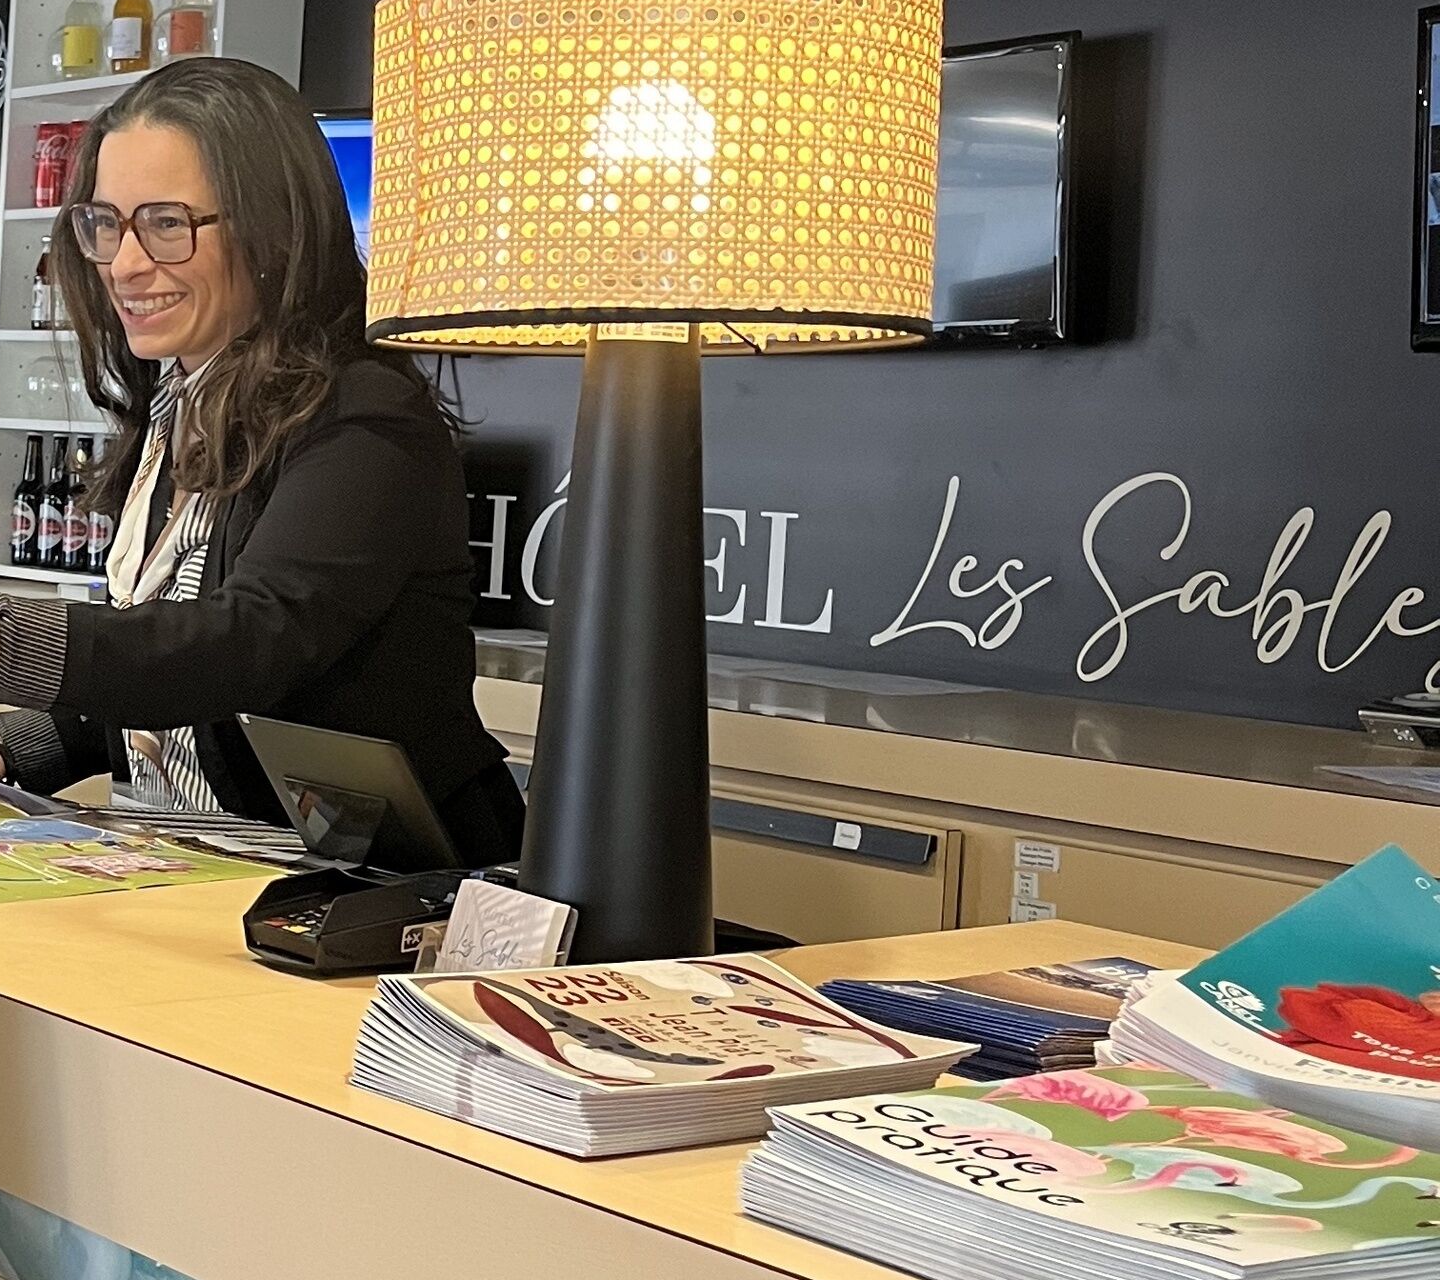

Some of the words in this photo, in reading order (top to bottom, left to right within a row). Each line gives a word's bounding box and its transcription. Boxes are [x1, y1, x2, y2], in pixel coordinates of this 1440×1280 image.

[466, 469, 834, 634] HEL
[870, 475, 1053, 650] Les
[1076, 471, 1440, 694] Sable
[523, 976, 589, 1006] 23
[564, 973, 629, 1004] 22
[603, 970, 651, 1001] Saison
[648, 1012, 713, 1038] Jean
[702, 1037, 766, 1057] Piat
[1351, 1031, 1416, 1055] Tous
[806, 1108, 1086, 1208] pratique
[875, 1103, 1058, 1176] Guide
